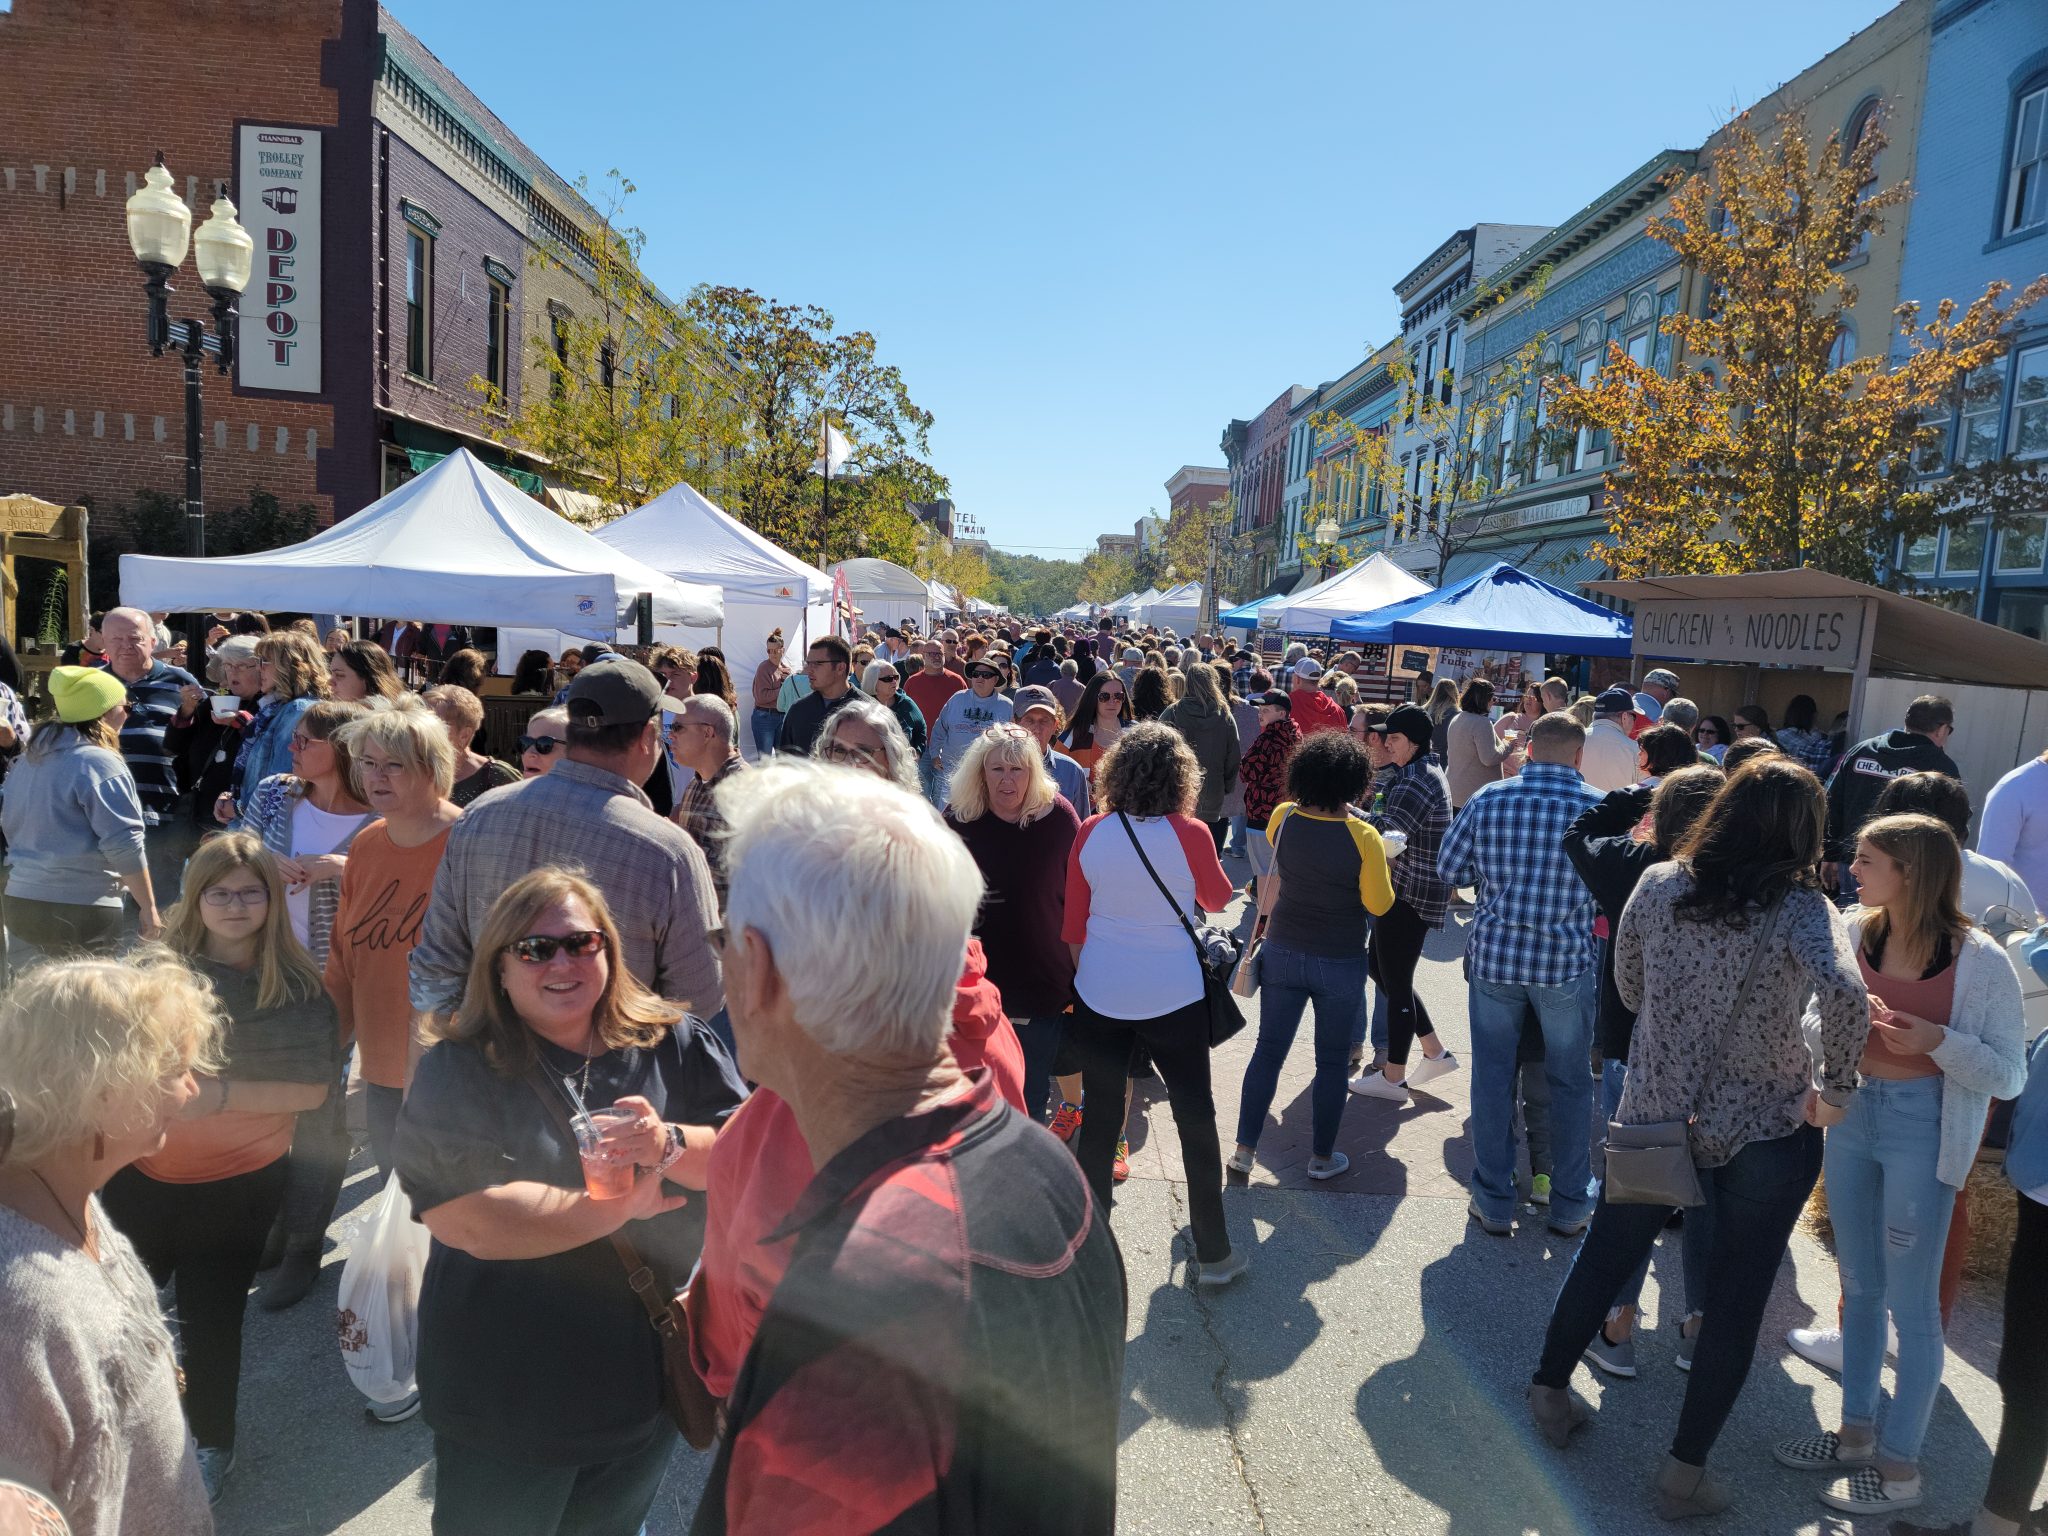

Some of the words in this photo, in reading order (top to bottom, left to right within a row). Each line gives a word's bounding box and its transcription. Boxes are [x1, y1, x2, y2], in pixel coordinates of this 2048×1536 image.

[260, 134, 300, 144] HANNIBAL
[258, 151, 304, 168] TROLLEY
[259, 167, 303, 179] COMPANY
[266, 227, 298, 366] DEPOT
[4, 518, 45, 531] garden
[958, 524, 986, 535] TWAIN
[1642, 611, 1714, 646] CHICKEN
[1745, 612, 1844, 652] NOODLES
[1440, 654, 1474, 670] Fudge
